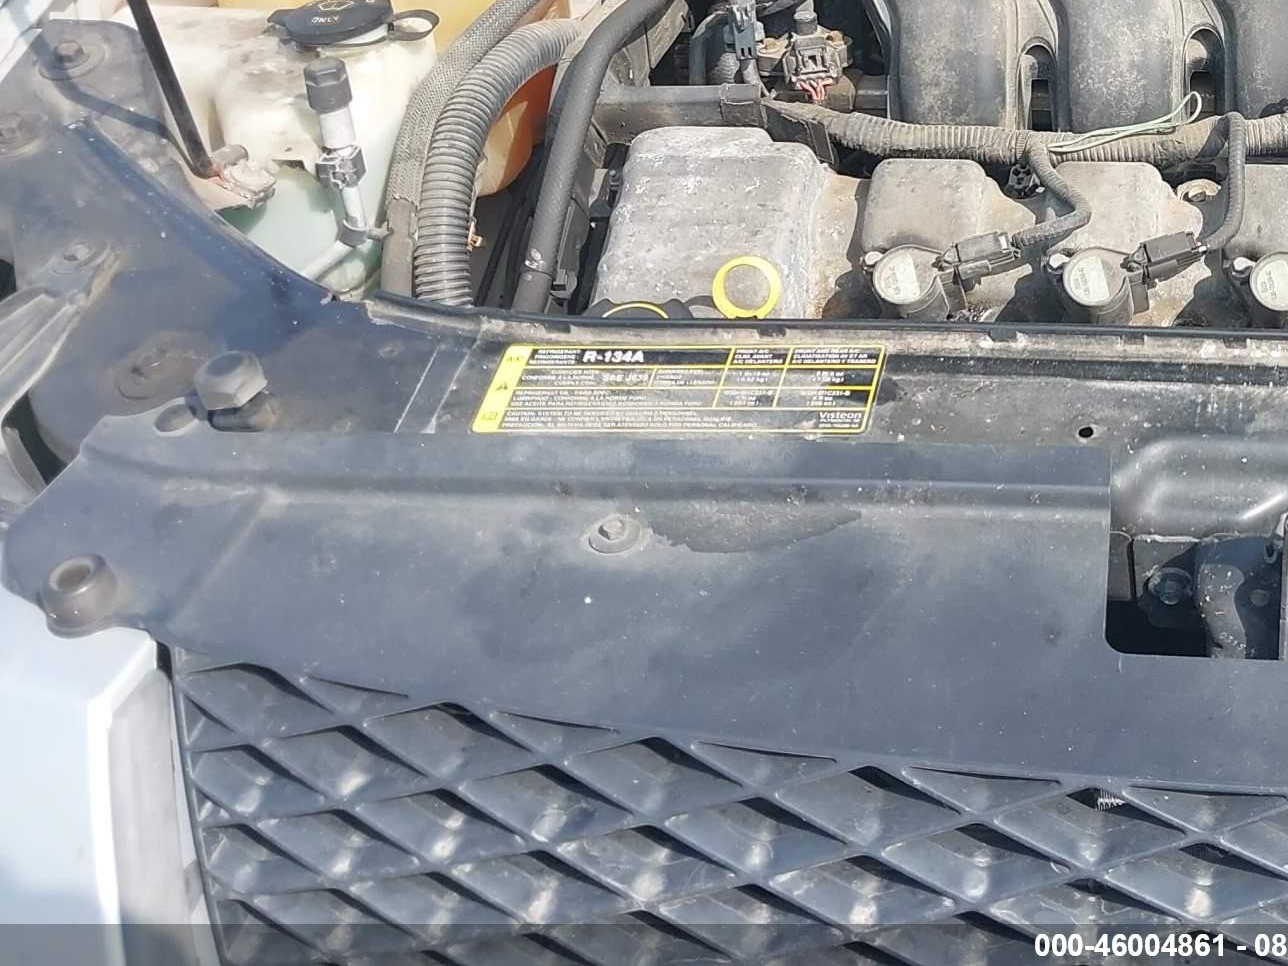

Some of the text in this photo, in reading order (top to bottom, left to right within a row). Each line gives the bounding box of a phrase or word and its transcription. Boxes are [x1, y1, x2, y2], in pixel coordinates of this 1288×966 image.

[582, 350, 644, 363] R-134A
[602, 373, 624, 381] SAE
[819, 411, 862, 419] Visteon
